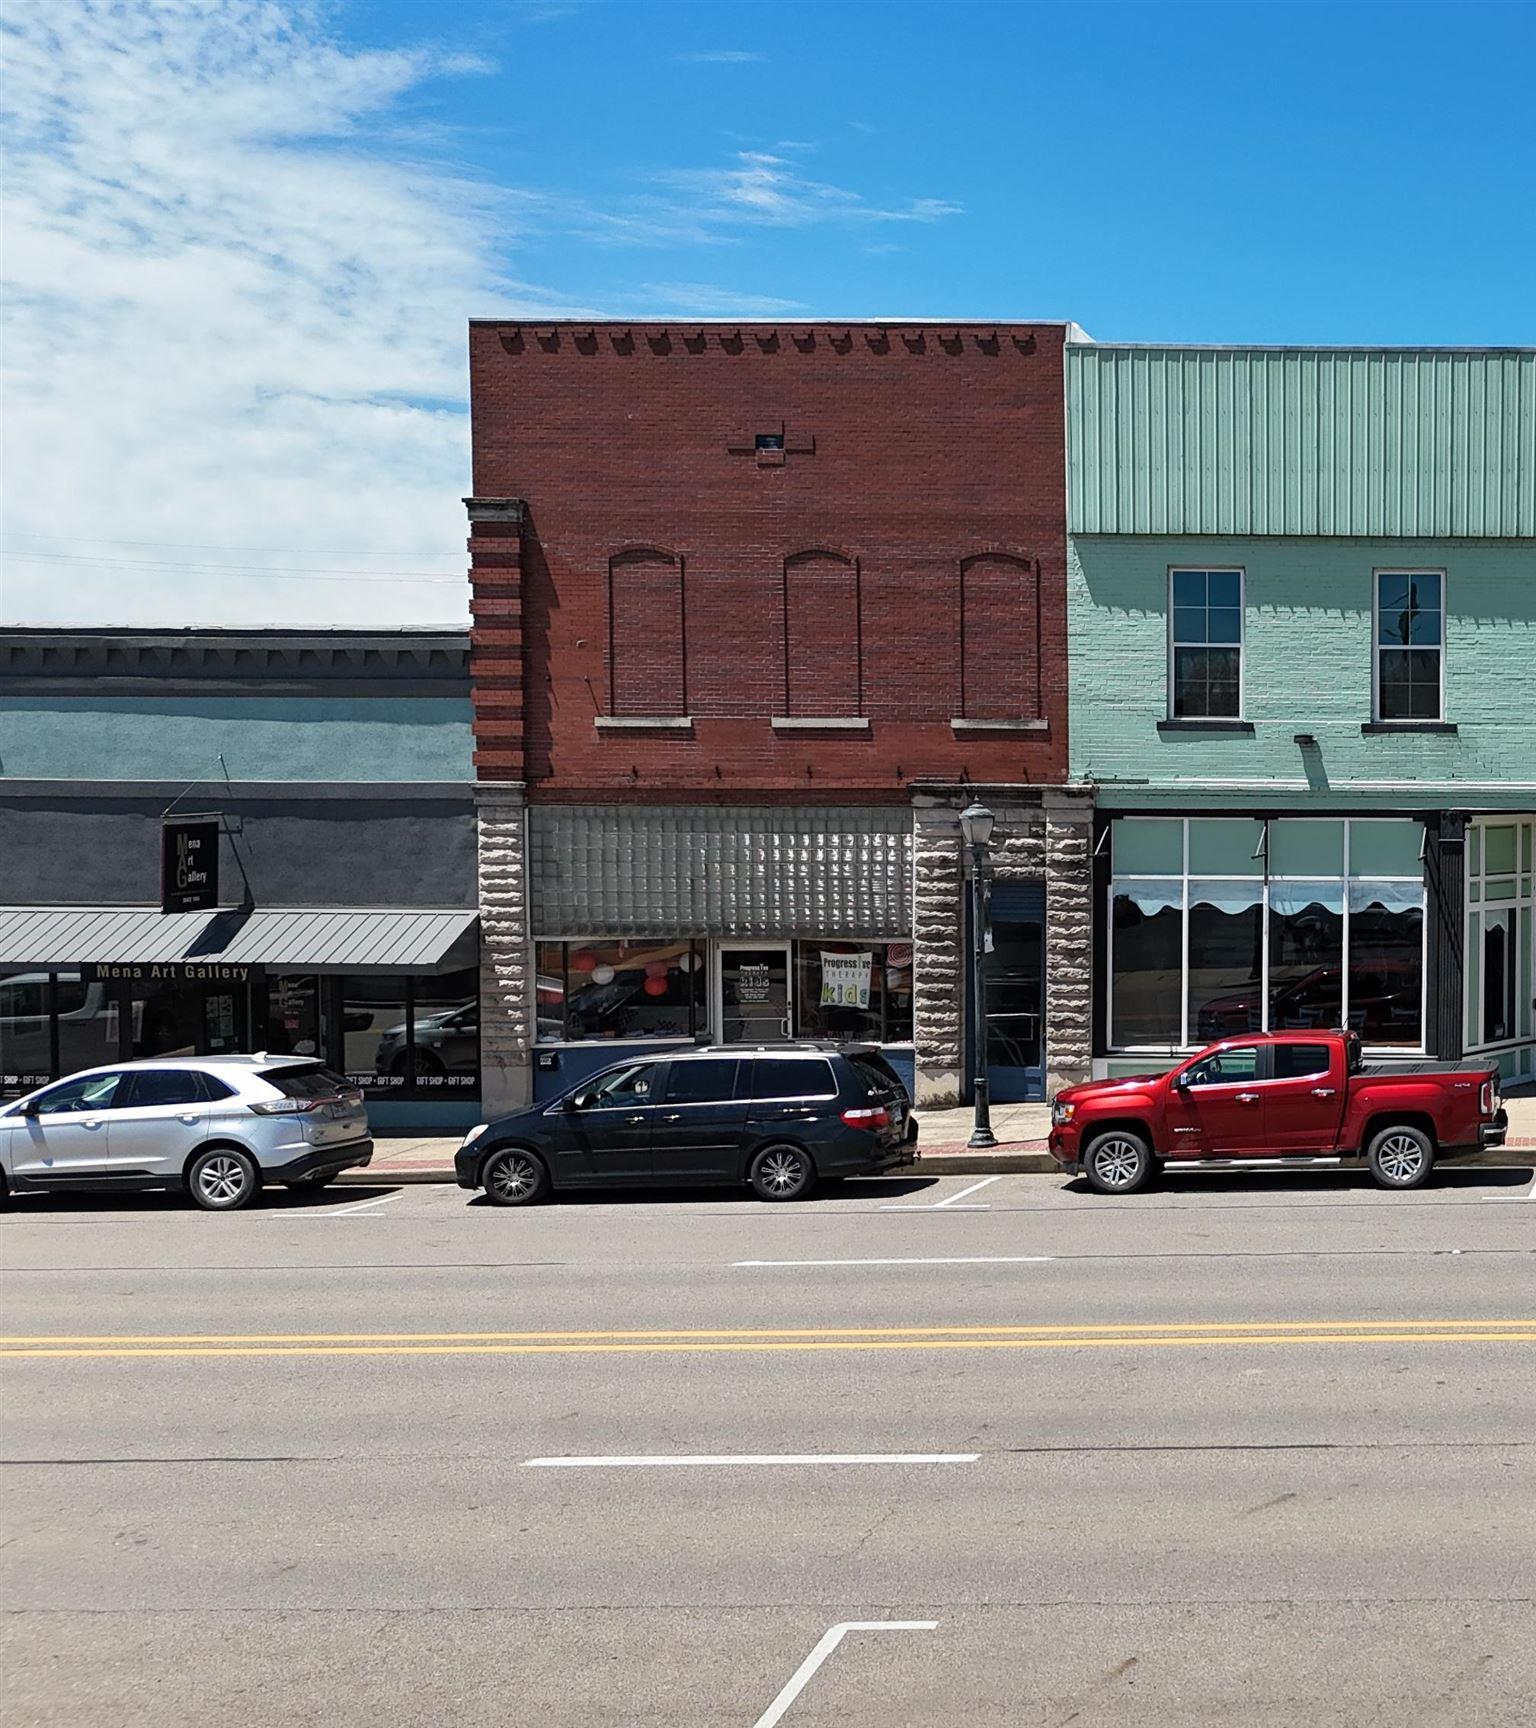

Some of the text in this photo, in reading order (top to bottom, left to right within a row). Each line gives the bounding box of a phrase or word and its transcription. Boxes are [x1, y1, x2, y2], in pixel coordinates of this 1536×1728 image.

[177, 833, 201, 855] Mena
[177, 867, 207, 888] Gallery
[96, 965, 249, 981] Mena Art Gallery
[825, 970, 869, 979] THERAPY
[822, 982, 869, 1004] kids
